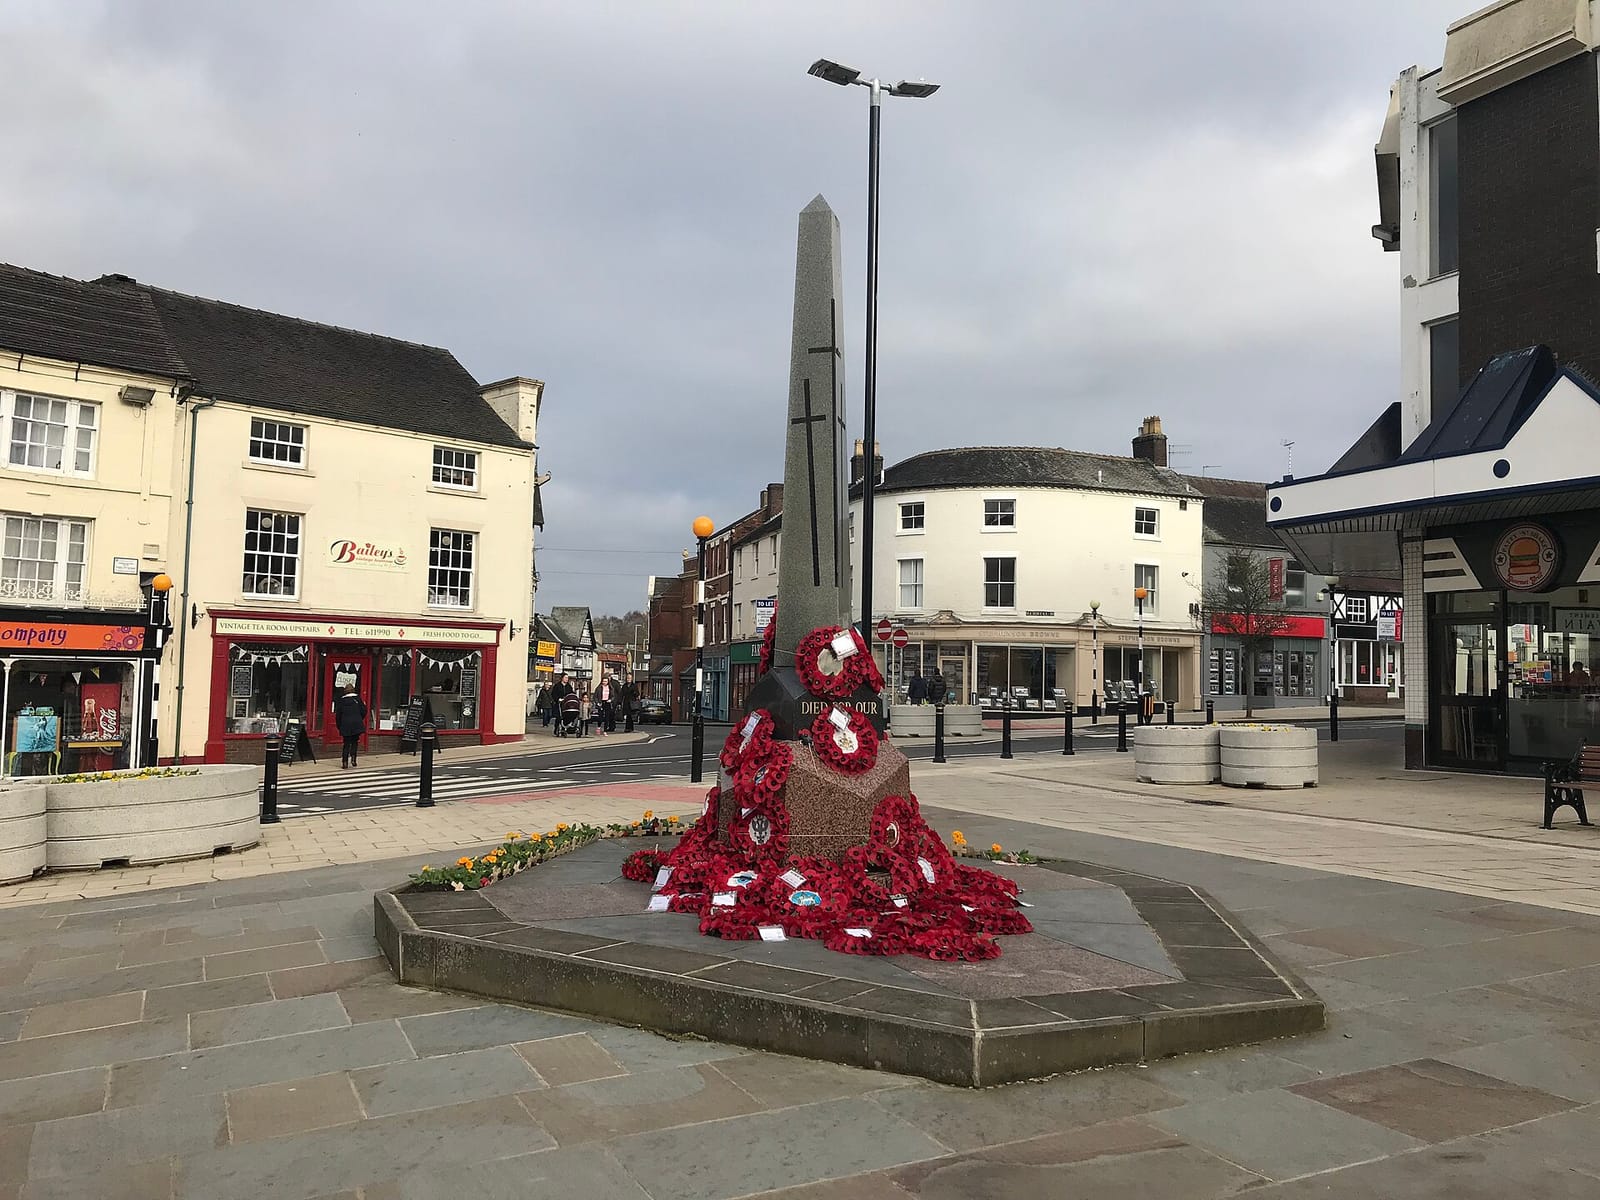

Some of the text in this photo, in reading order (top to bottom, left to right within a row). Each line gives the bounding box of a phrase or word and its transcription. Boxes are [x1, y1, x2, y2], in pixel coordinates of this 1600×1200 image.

[220, 622, 250, 630] VINTAGE
[289, 625, 320, 633] UPSTAIRS
[344, 627, 391, 637] TEL: 611990
[0, 626, 67, 646] ompany
[801, 701, 829, 714] DIED
[855, 701, 878, 714] OUR
